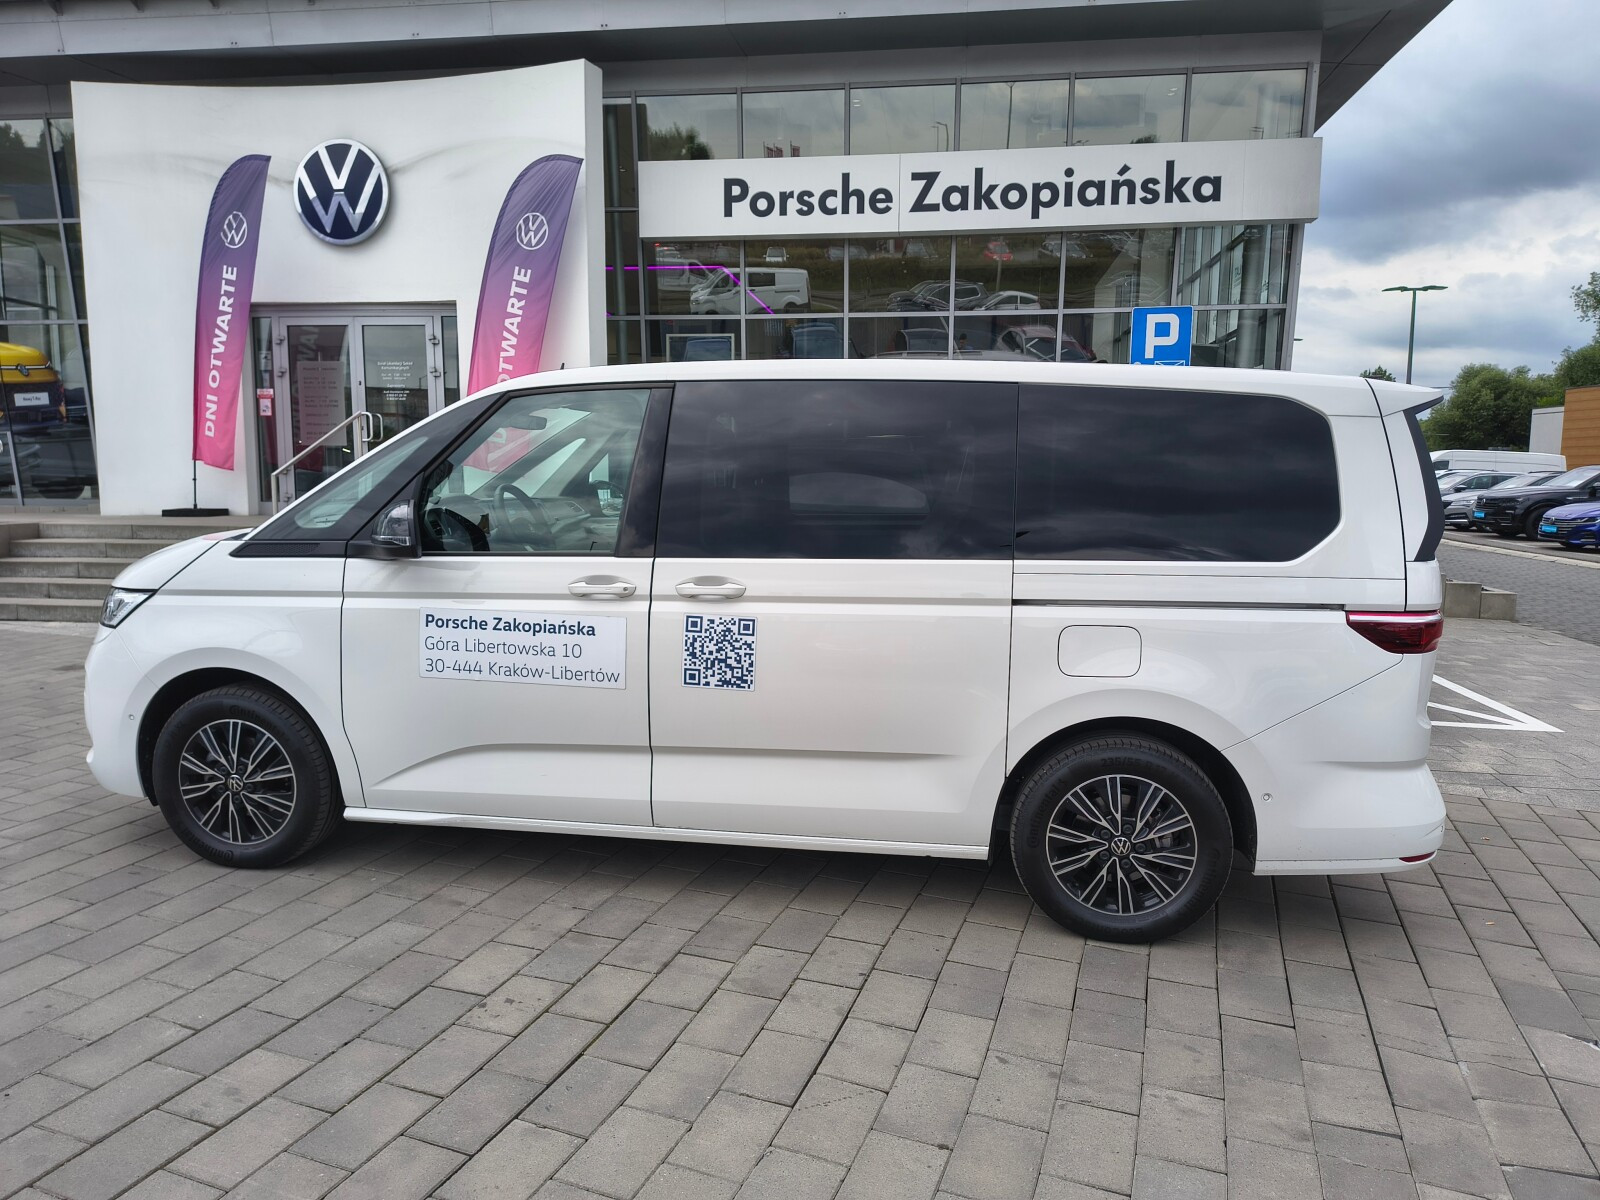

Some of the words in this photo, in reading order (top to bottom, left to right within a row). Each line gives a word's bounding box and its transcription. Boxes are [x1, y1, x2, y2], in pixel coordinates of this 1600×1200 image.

[723, 172, 894, 218] Porsche
[909, 160, 1223, 220] Zakopiańska
[208, 264, 238, 389] OTWARTE
[1145, 313, 1180, 359] P
[204, 394, 219, 438] DNI
[424, 635, 459, 652] Góra
[465, 638, 556, 658] Libertowska
[562, 643, 582, 659] 10
[425, 614, 488, 631] Porsche
[492, 617, 596, 637] Zakopiańska
[425, 658, 483, 676] 30-444
[488, 661, 620, 684] Kraków-Libertów
